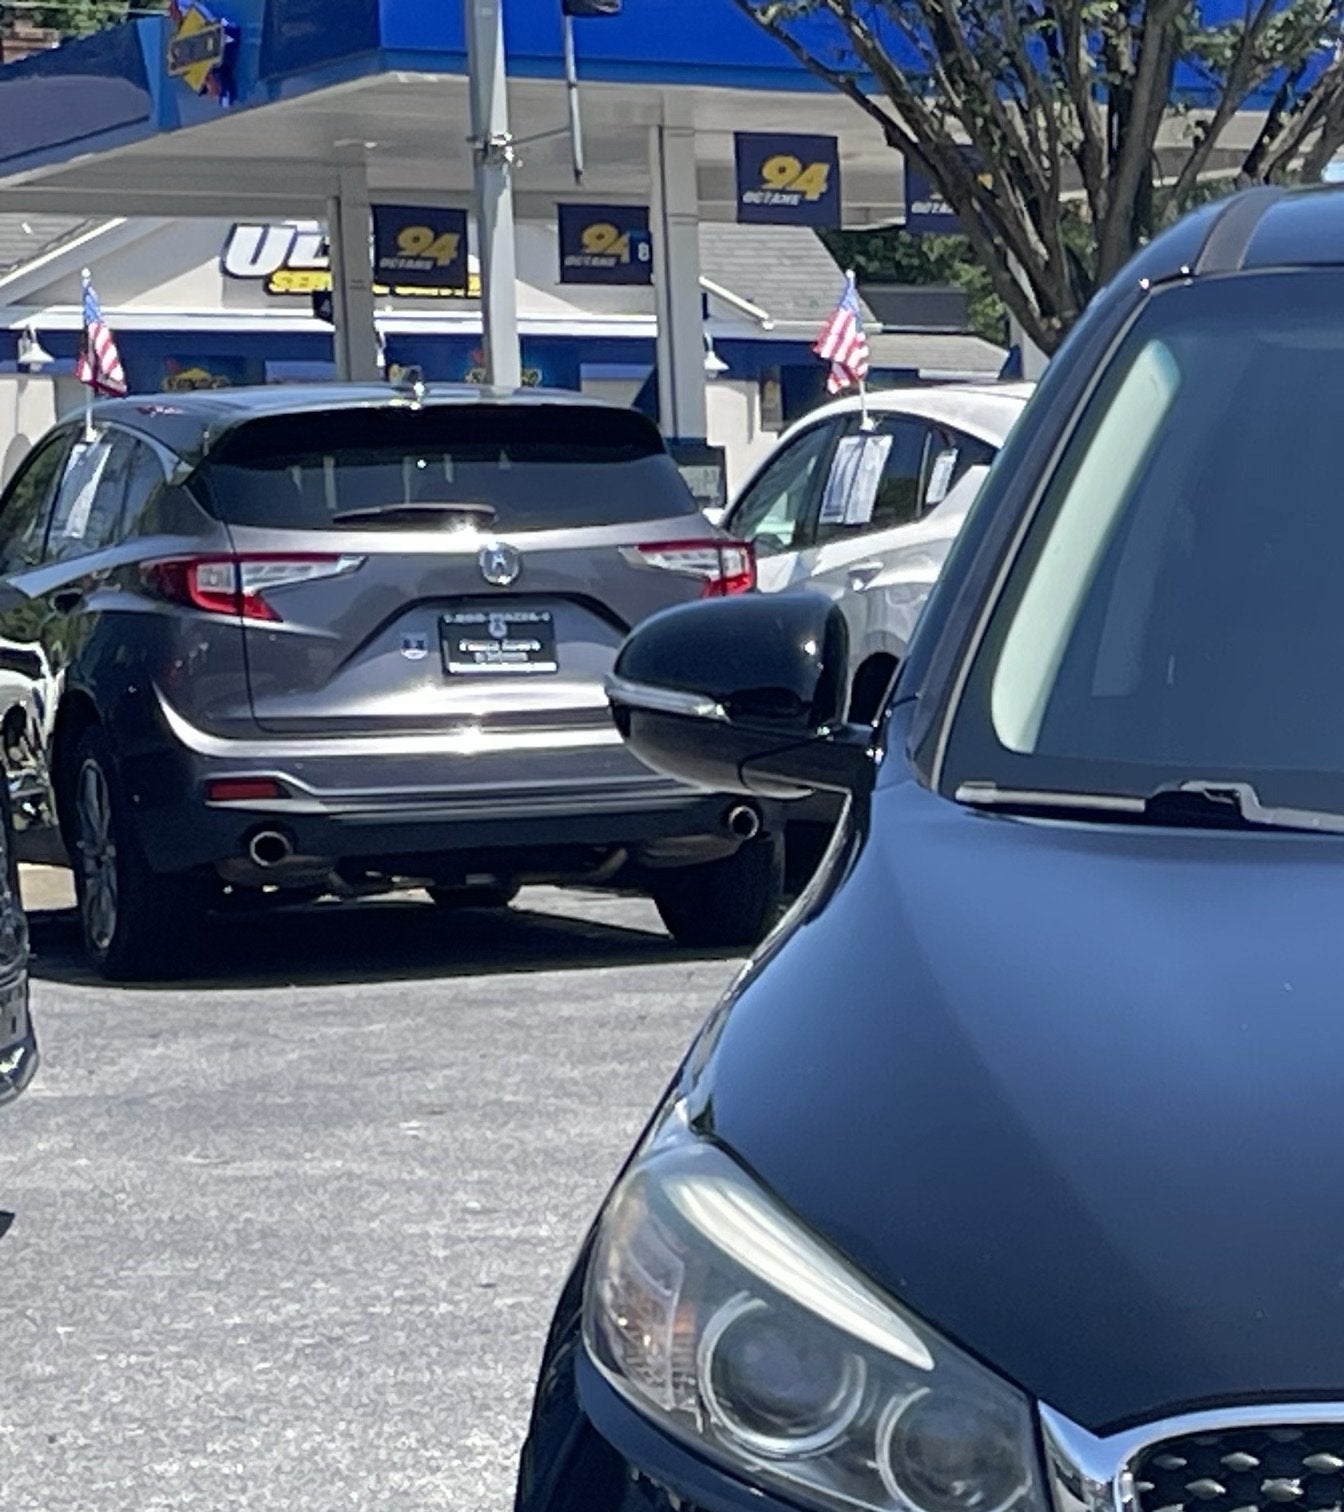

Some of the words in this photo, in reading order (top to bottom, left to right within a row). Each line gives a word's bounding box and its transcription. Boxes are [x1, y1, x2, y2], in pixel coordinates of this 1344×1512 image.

[761, 154, 830, 200] 94
[396, 226, 461, 267] 94
[581, 223, 630, 264] 94
